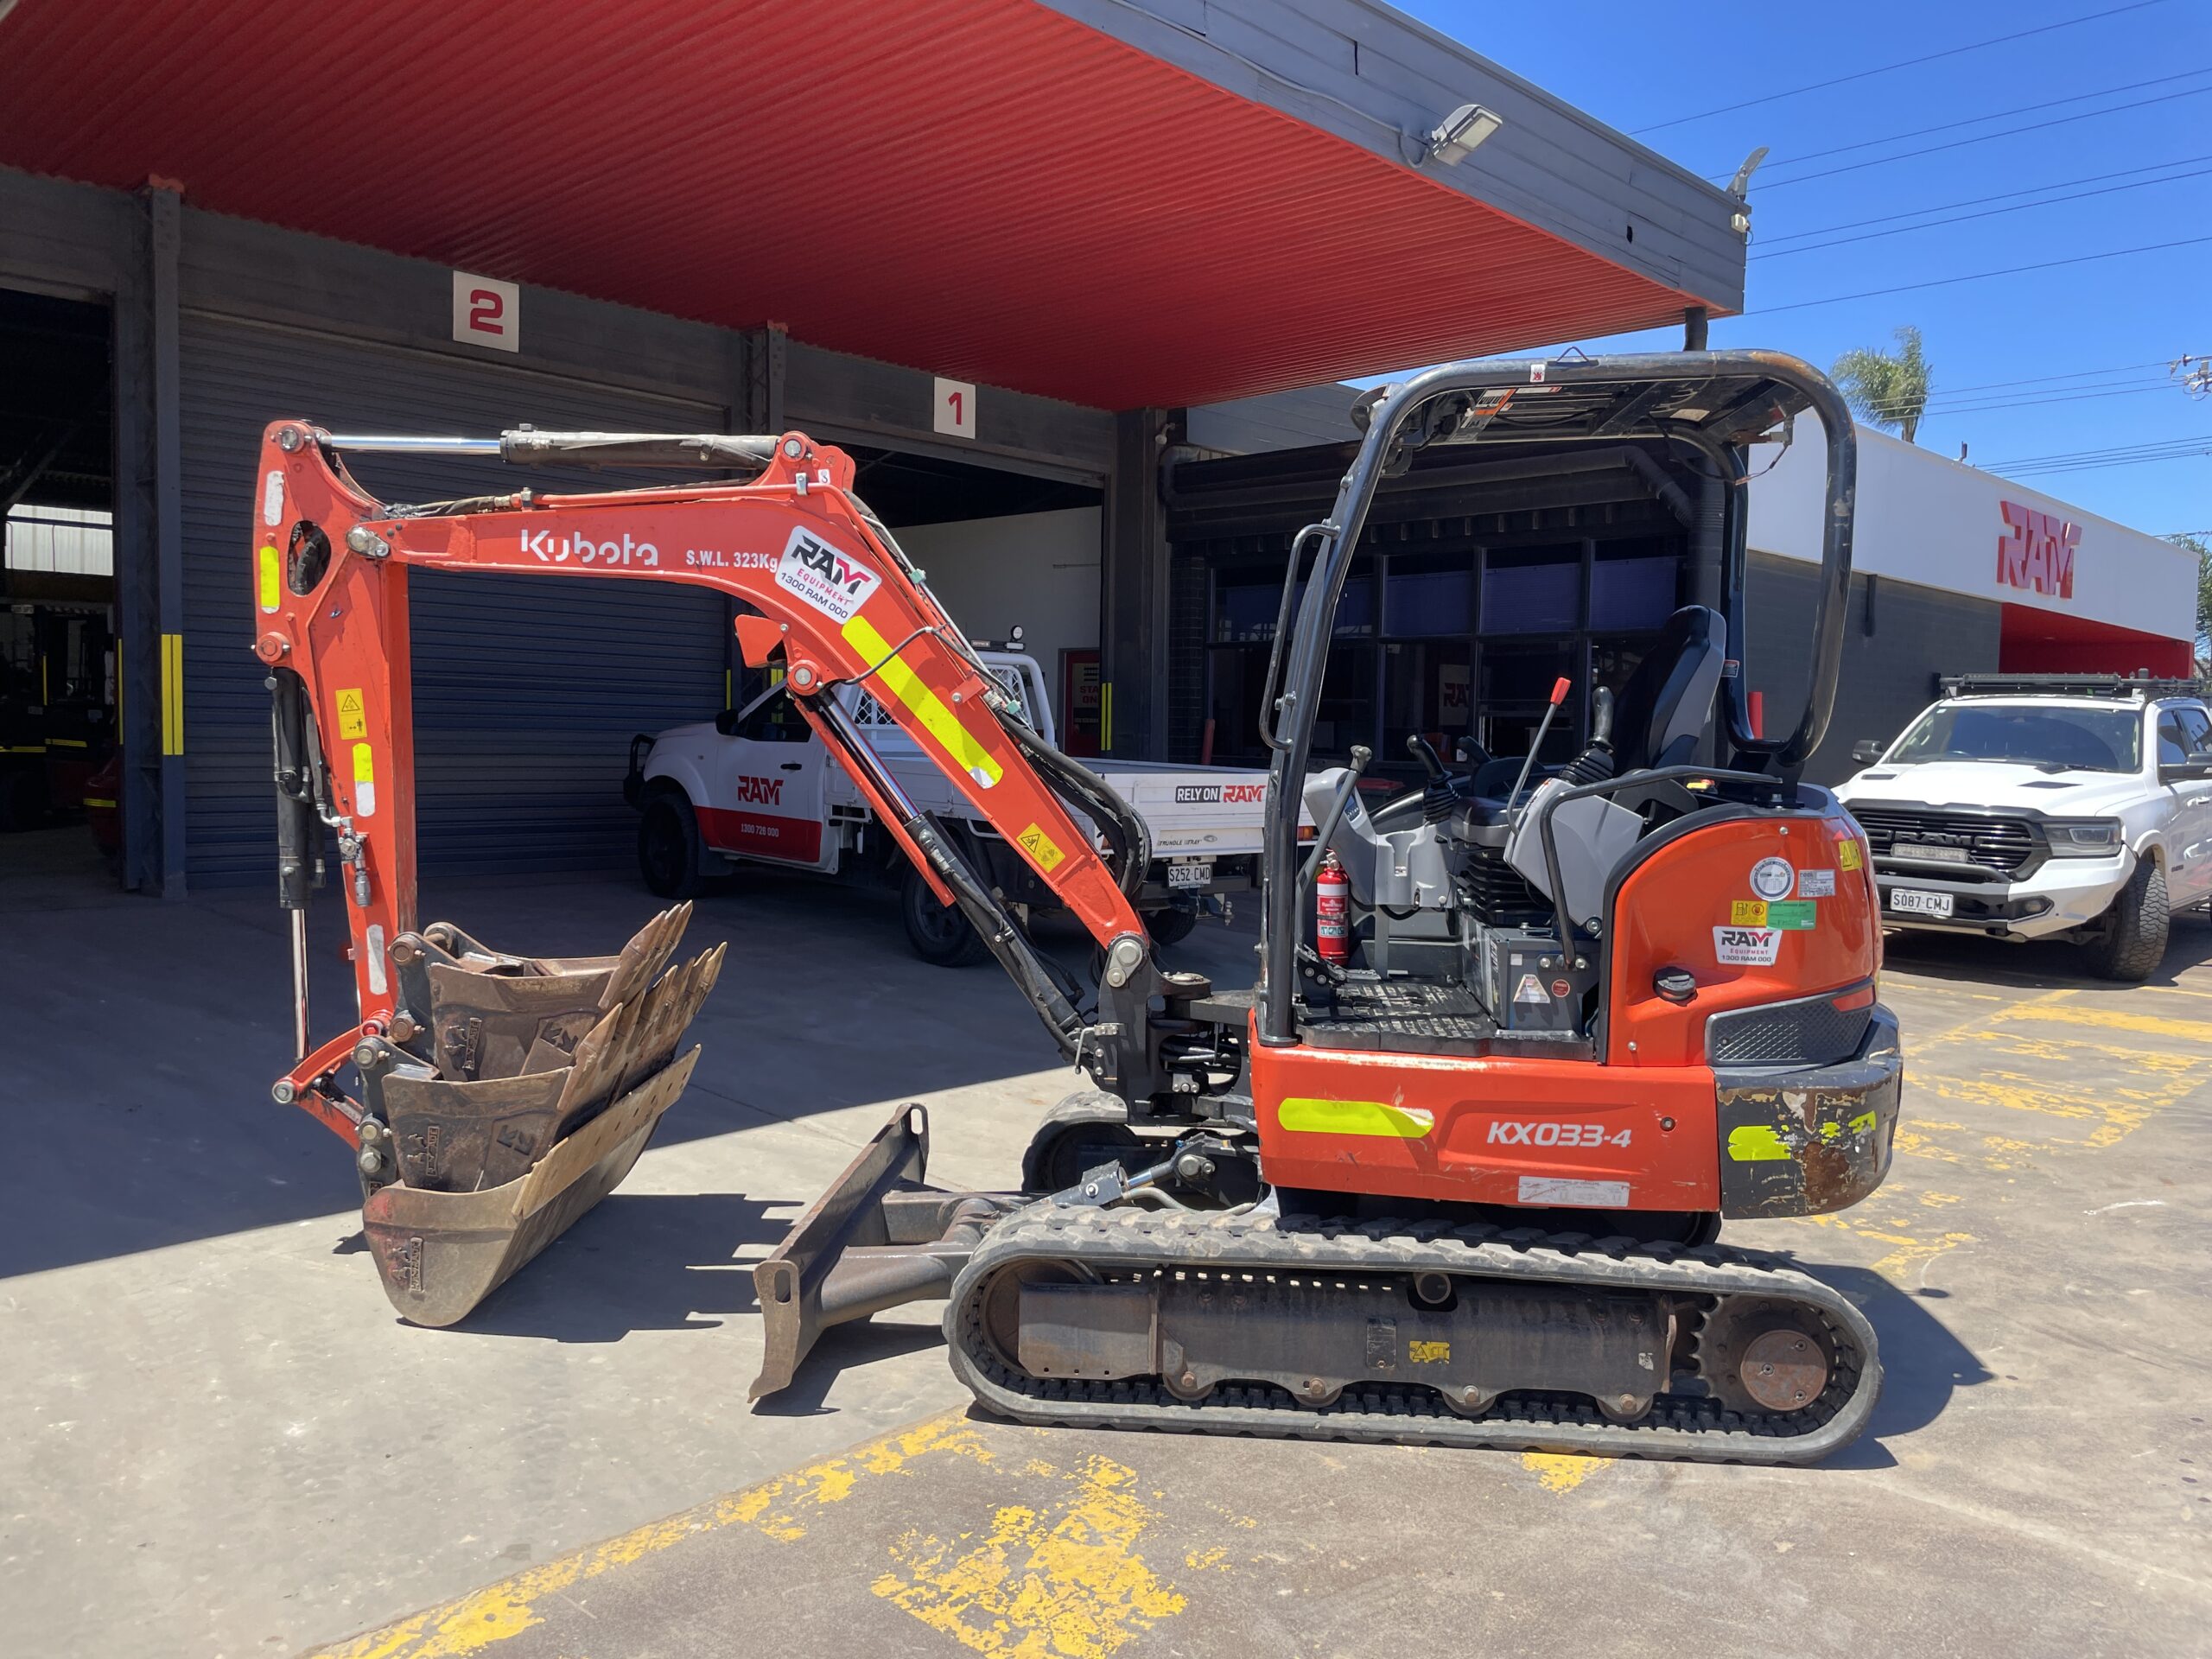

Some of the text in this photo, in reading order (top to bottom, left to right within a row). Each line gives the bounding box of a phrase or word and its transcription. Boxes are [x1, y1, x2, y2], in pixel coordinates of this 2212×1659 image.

[470, 289, 504, 335] 2
[948, 391, 962, 426] 1
[521, 529, 658, 567] Kubota
[686, 550, 778, 573] S.W.L. 323Kg
[791, 535, 872, 594] RAM
[1997, 500, 2082, 599] RAM
[781, 572, 849, 620] 1300 RAM 000
[797, 568, 854, 606] EQUIPMENT
[737, 775, 784, 806] RAM
[1177, 785, 1266, 803] RELY ON RAM
[741, 823, 754, 834] 1300
[1722, 931, 1774, 947] RAM
[1487, 1122, 1631, 1148] KX033-4
